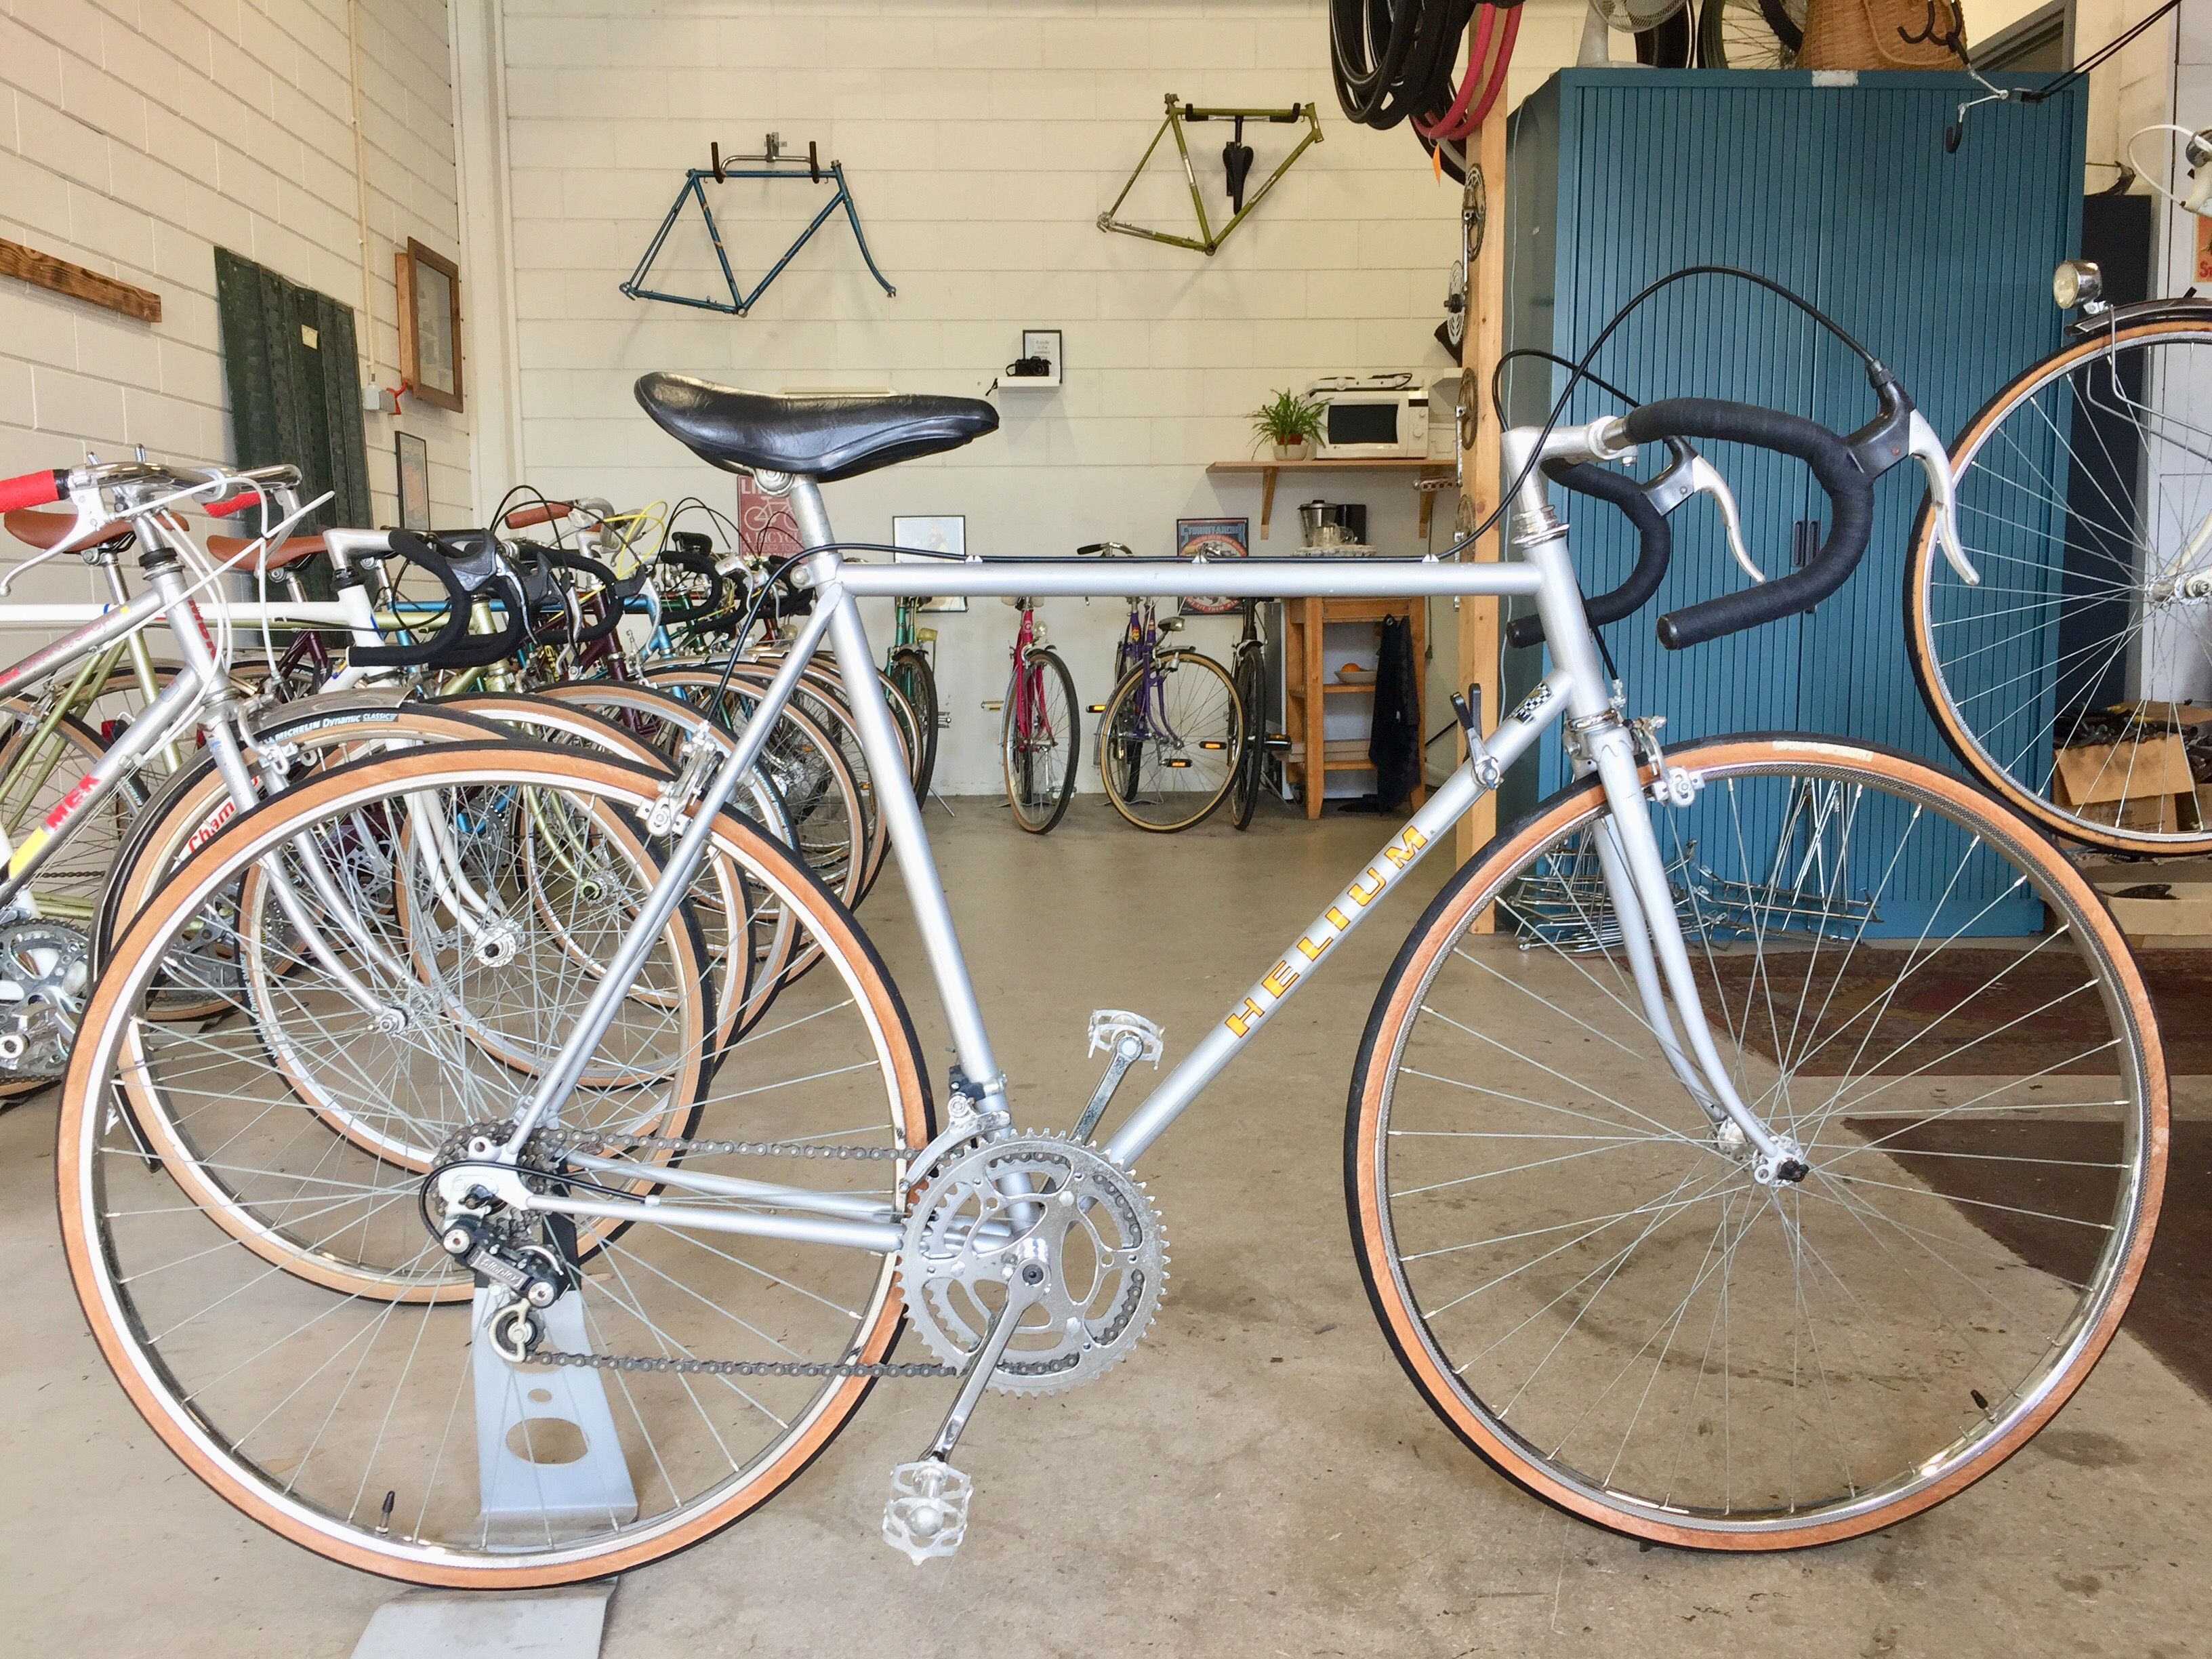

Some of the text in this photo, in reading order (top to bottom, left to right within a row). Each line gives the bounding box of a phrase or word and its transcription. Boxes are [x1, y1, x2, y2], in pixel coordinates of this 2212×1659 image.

[755, 531, 802, 544] BICYCL
[274, 712, 392, 741] MICHELIN Dynamic CLASSIC
[125, 781, 143, 806] ICHELIN
[1225, 825, 1428, 1038] HELIUM
